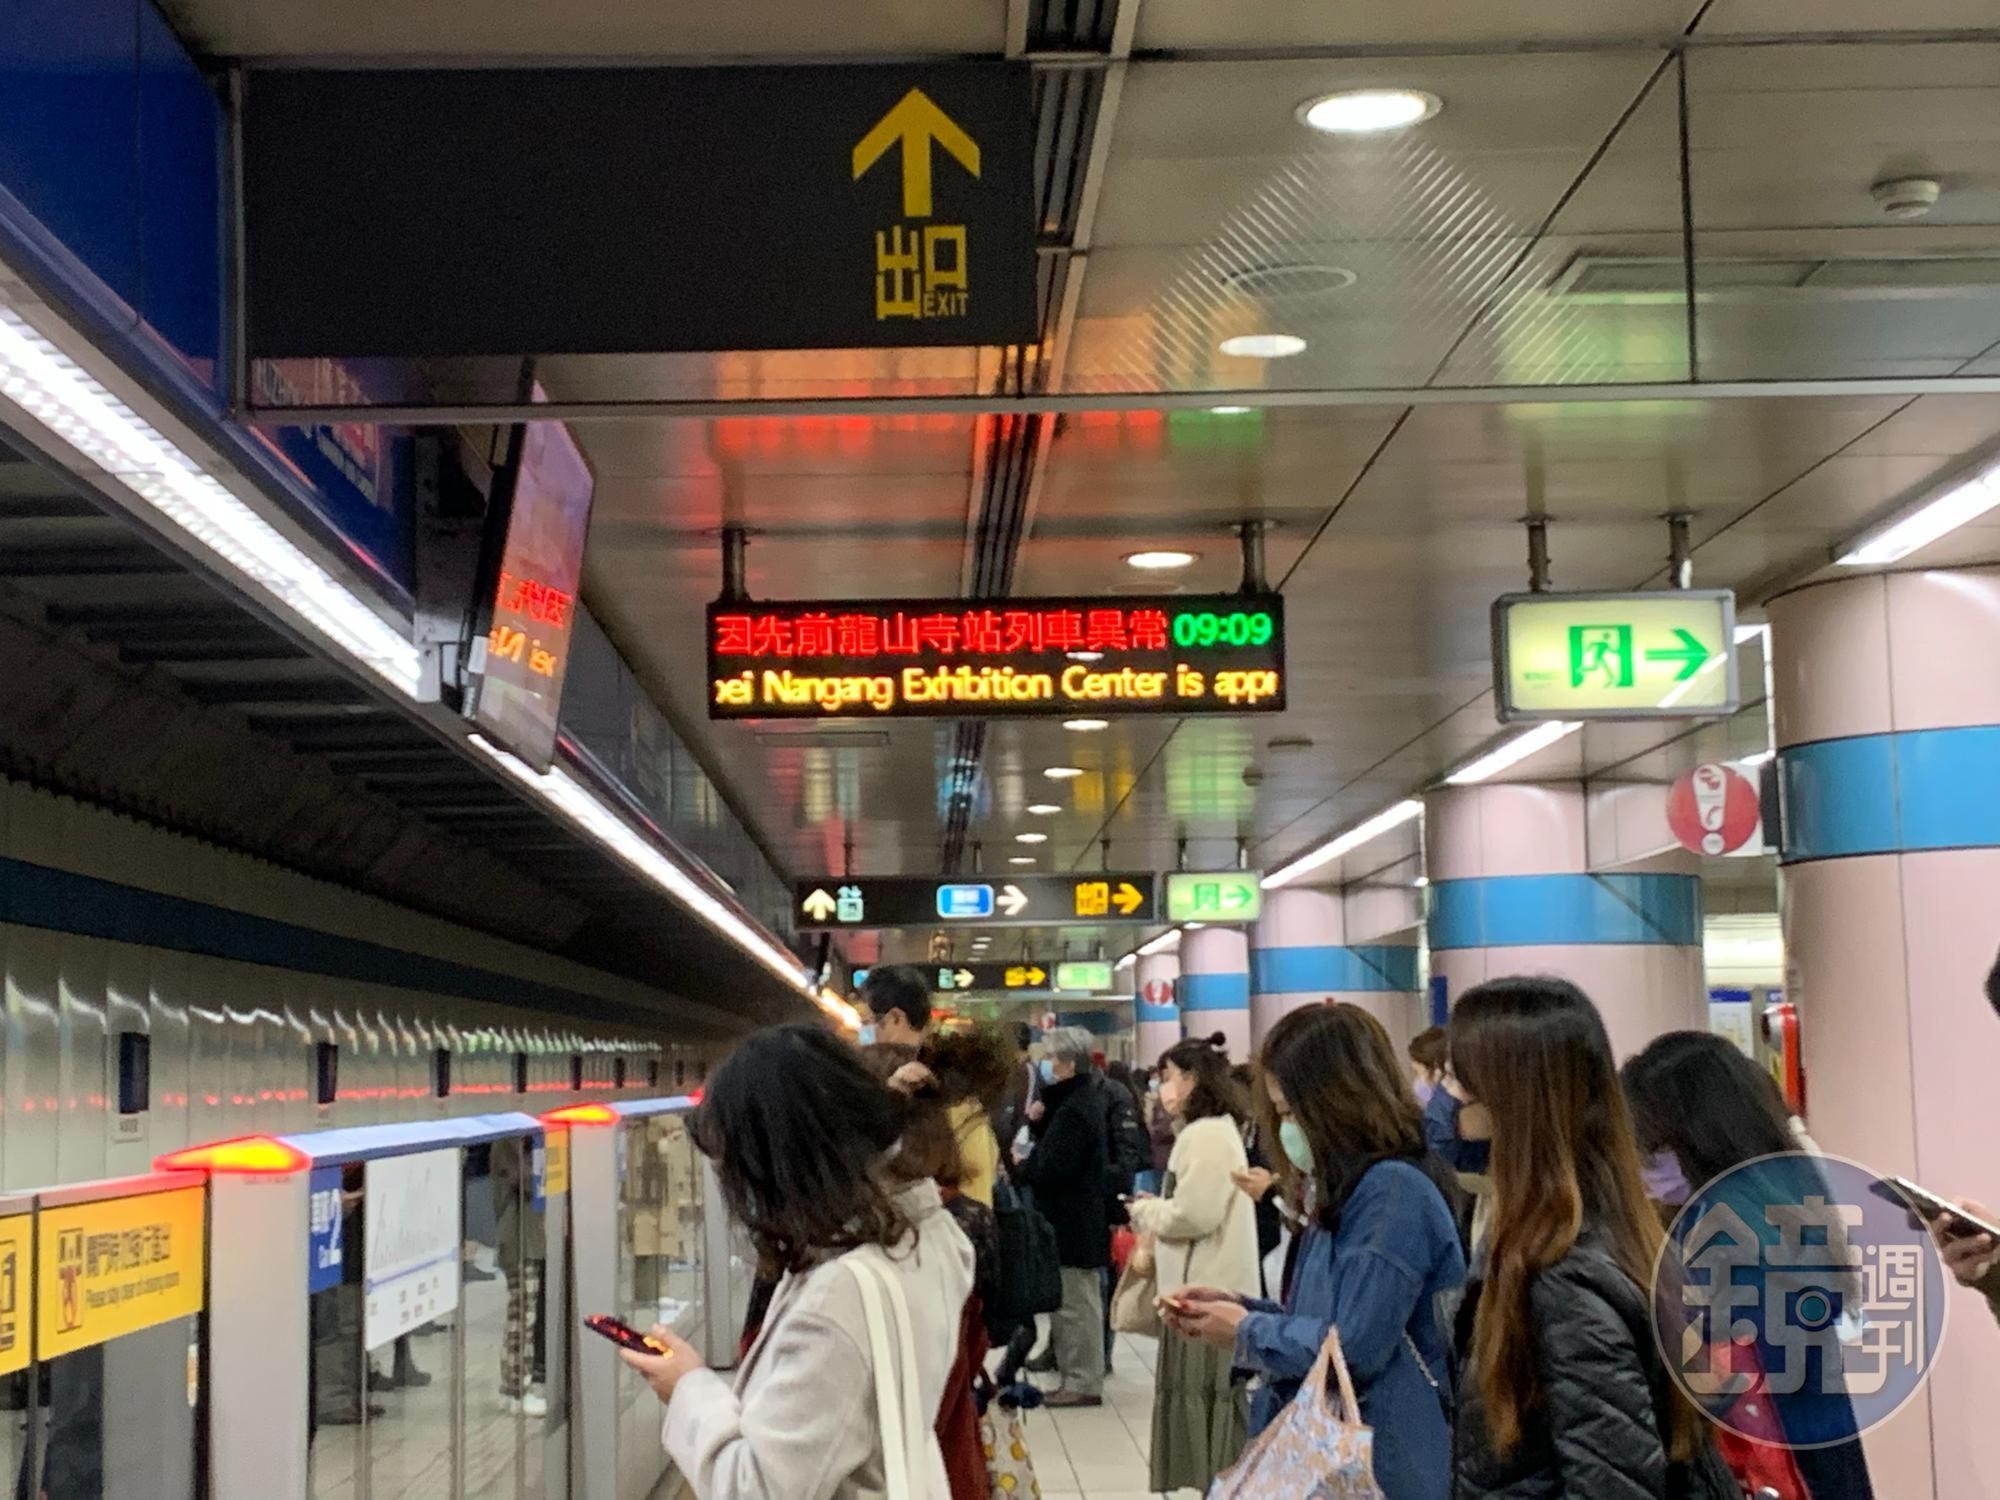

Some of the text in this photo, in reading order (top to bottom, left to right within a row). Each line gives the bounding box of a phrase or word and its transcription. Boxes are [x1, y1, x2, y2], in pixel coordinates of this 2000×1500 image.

[876, 225, 966, 320] 出口
[922, 293, 968, 316] EXIT
[715, 610, 1168, 656] 因先前龍山寺站列車異常
[1173, 613, 1273, 646] 09:09
[763, 670, 894, 710] Nangang
[902, 665, 1053, 701] Exhibition
[1061, 665, 1167, 699] Center
[1176, 664, 1204, 697] is
